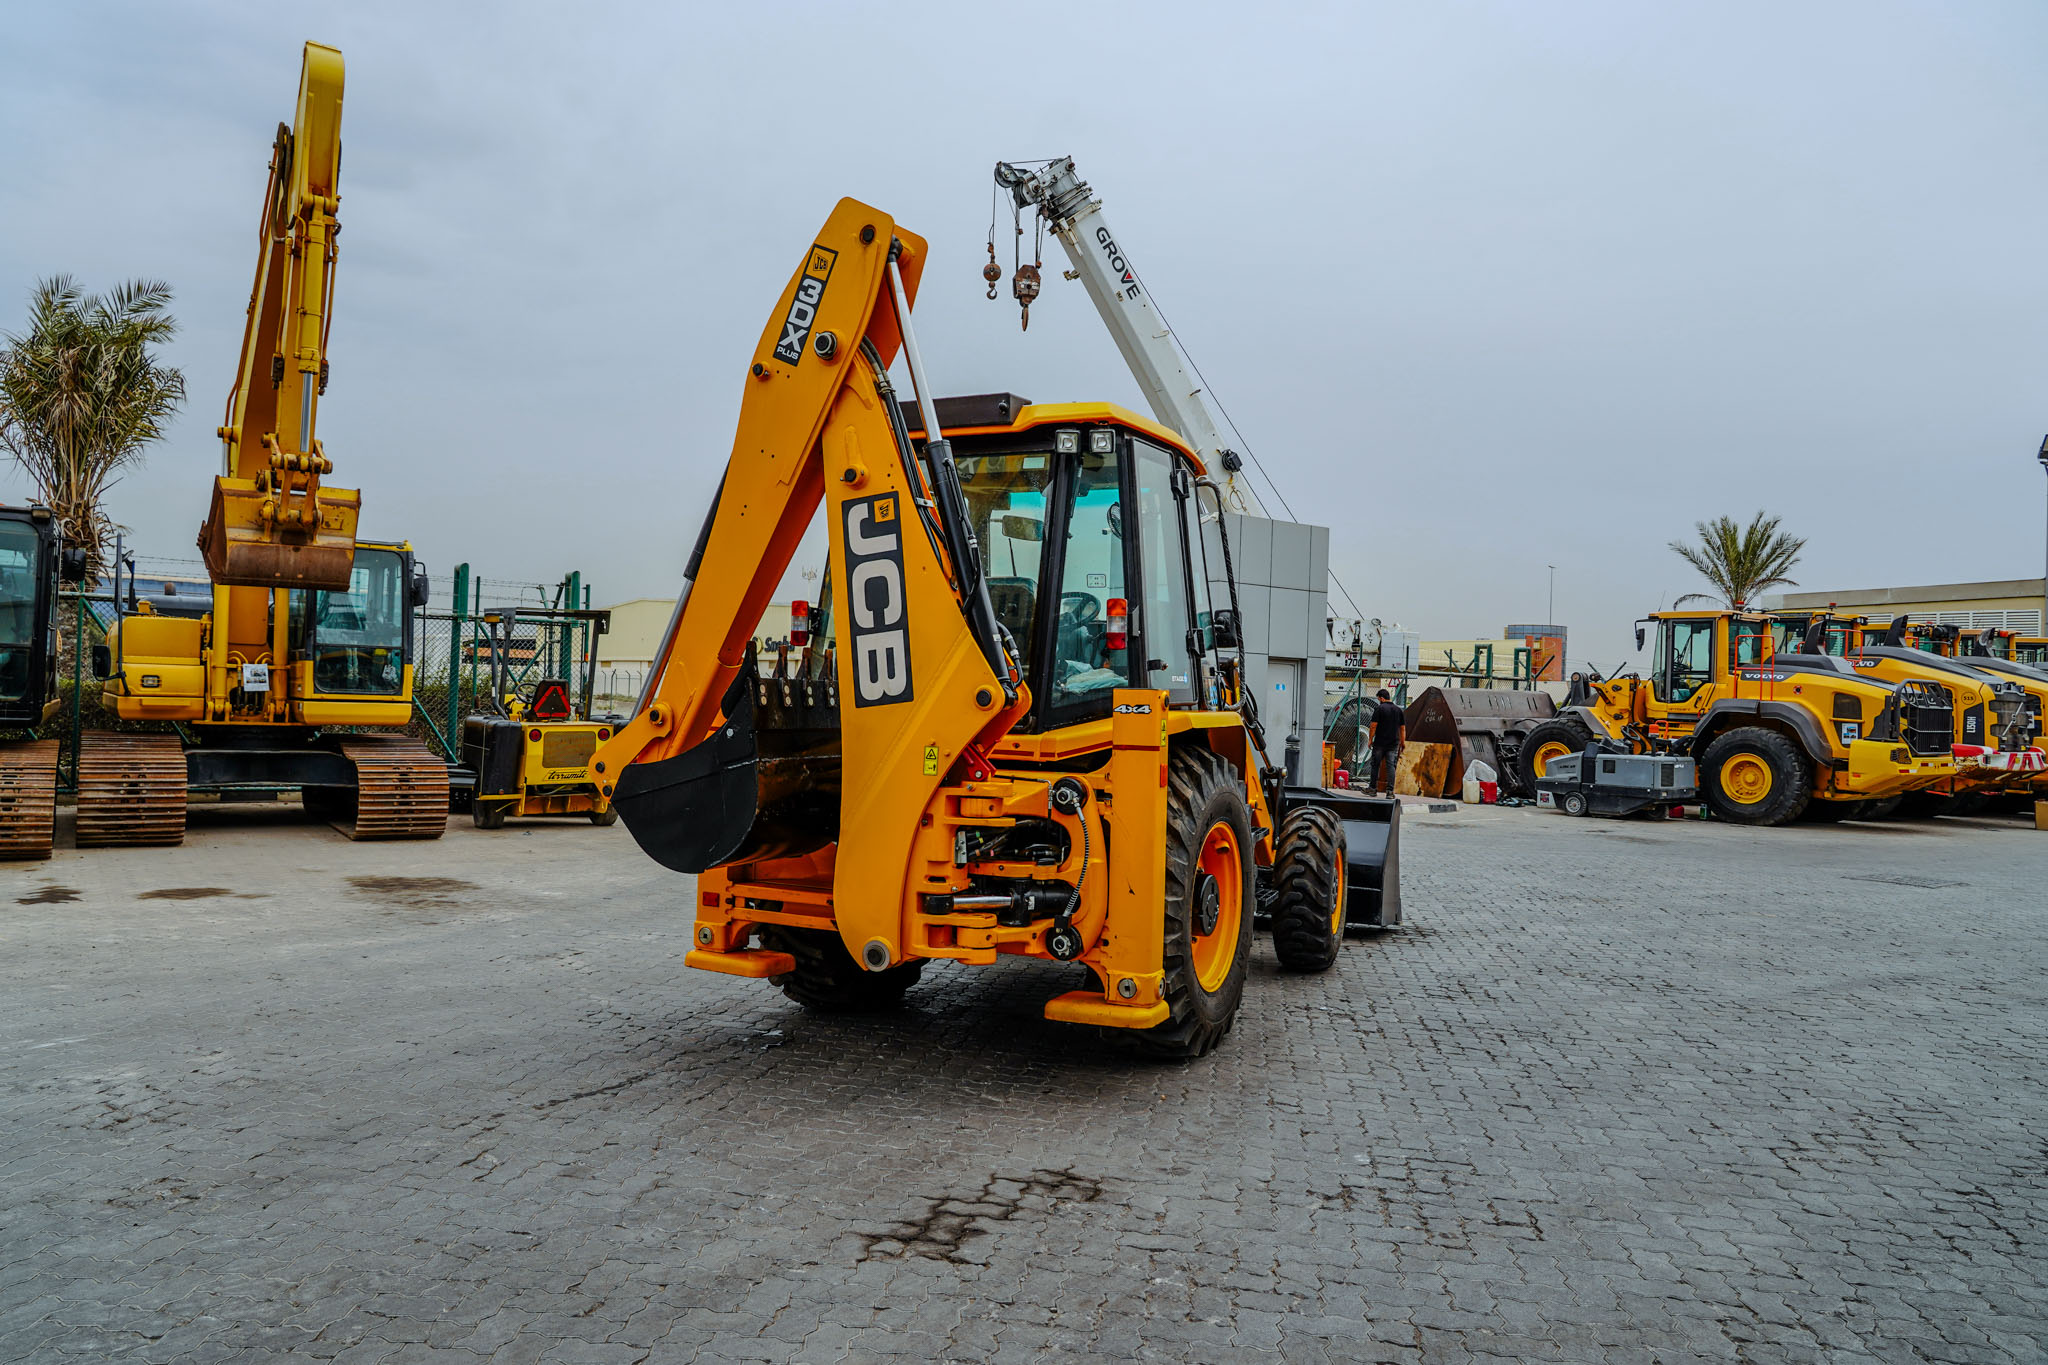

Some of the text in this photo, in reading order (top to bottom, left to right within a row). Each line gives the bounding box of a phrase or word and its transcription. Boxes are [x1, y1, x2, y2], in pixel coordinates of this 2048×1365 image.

[814, 255, 827, 270] JCB
[1096, 226, 1141, 300] GROVE
[779, 278, 822, 353] 3DX
[776, 346, 799, 360] PLUS
[879, 503, 889, 519] JCB
[847, 502, 907, 701] JCB
